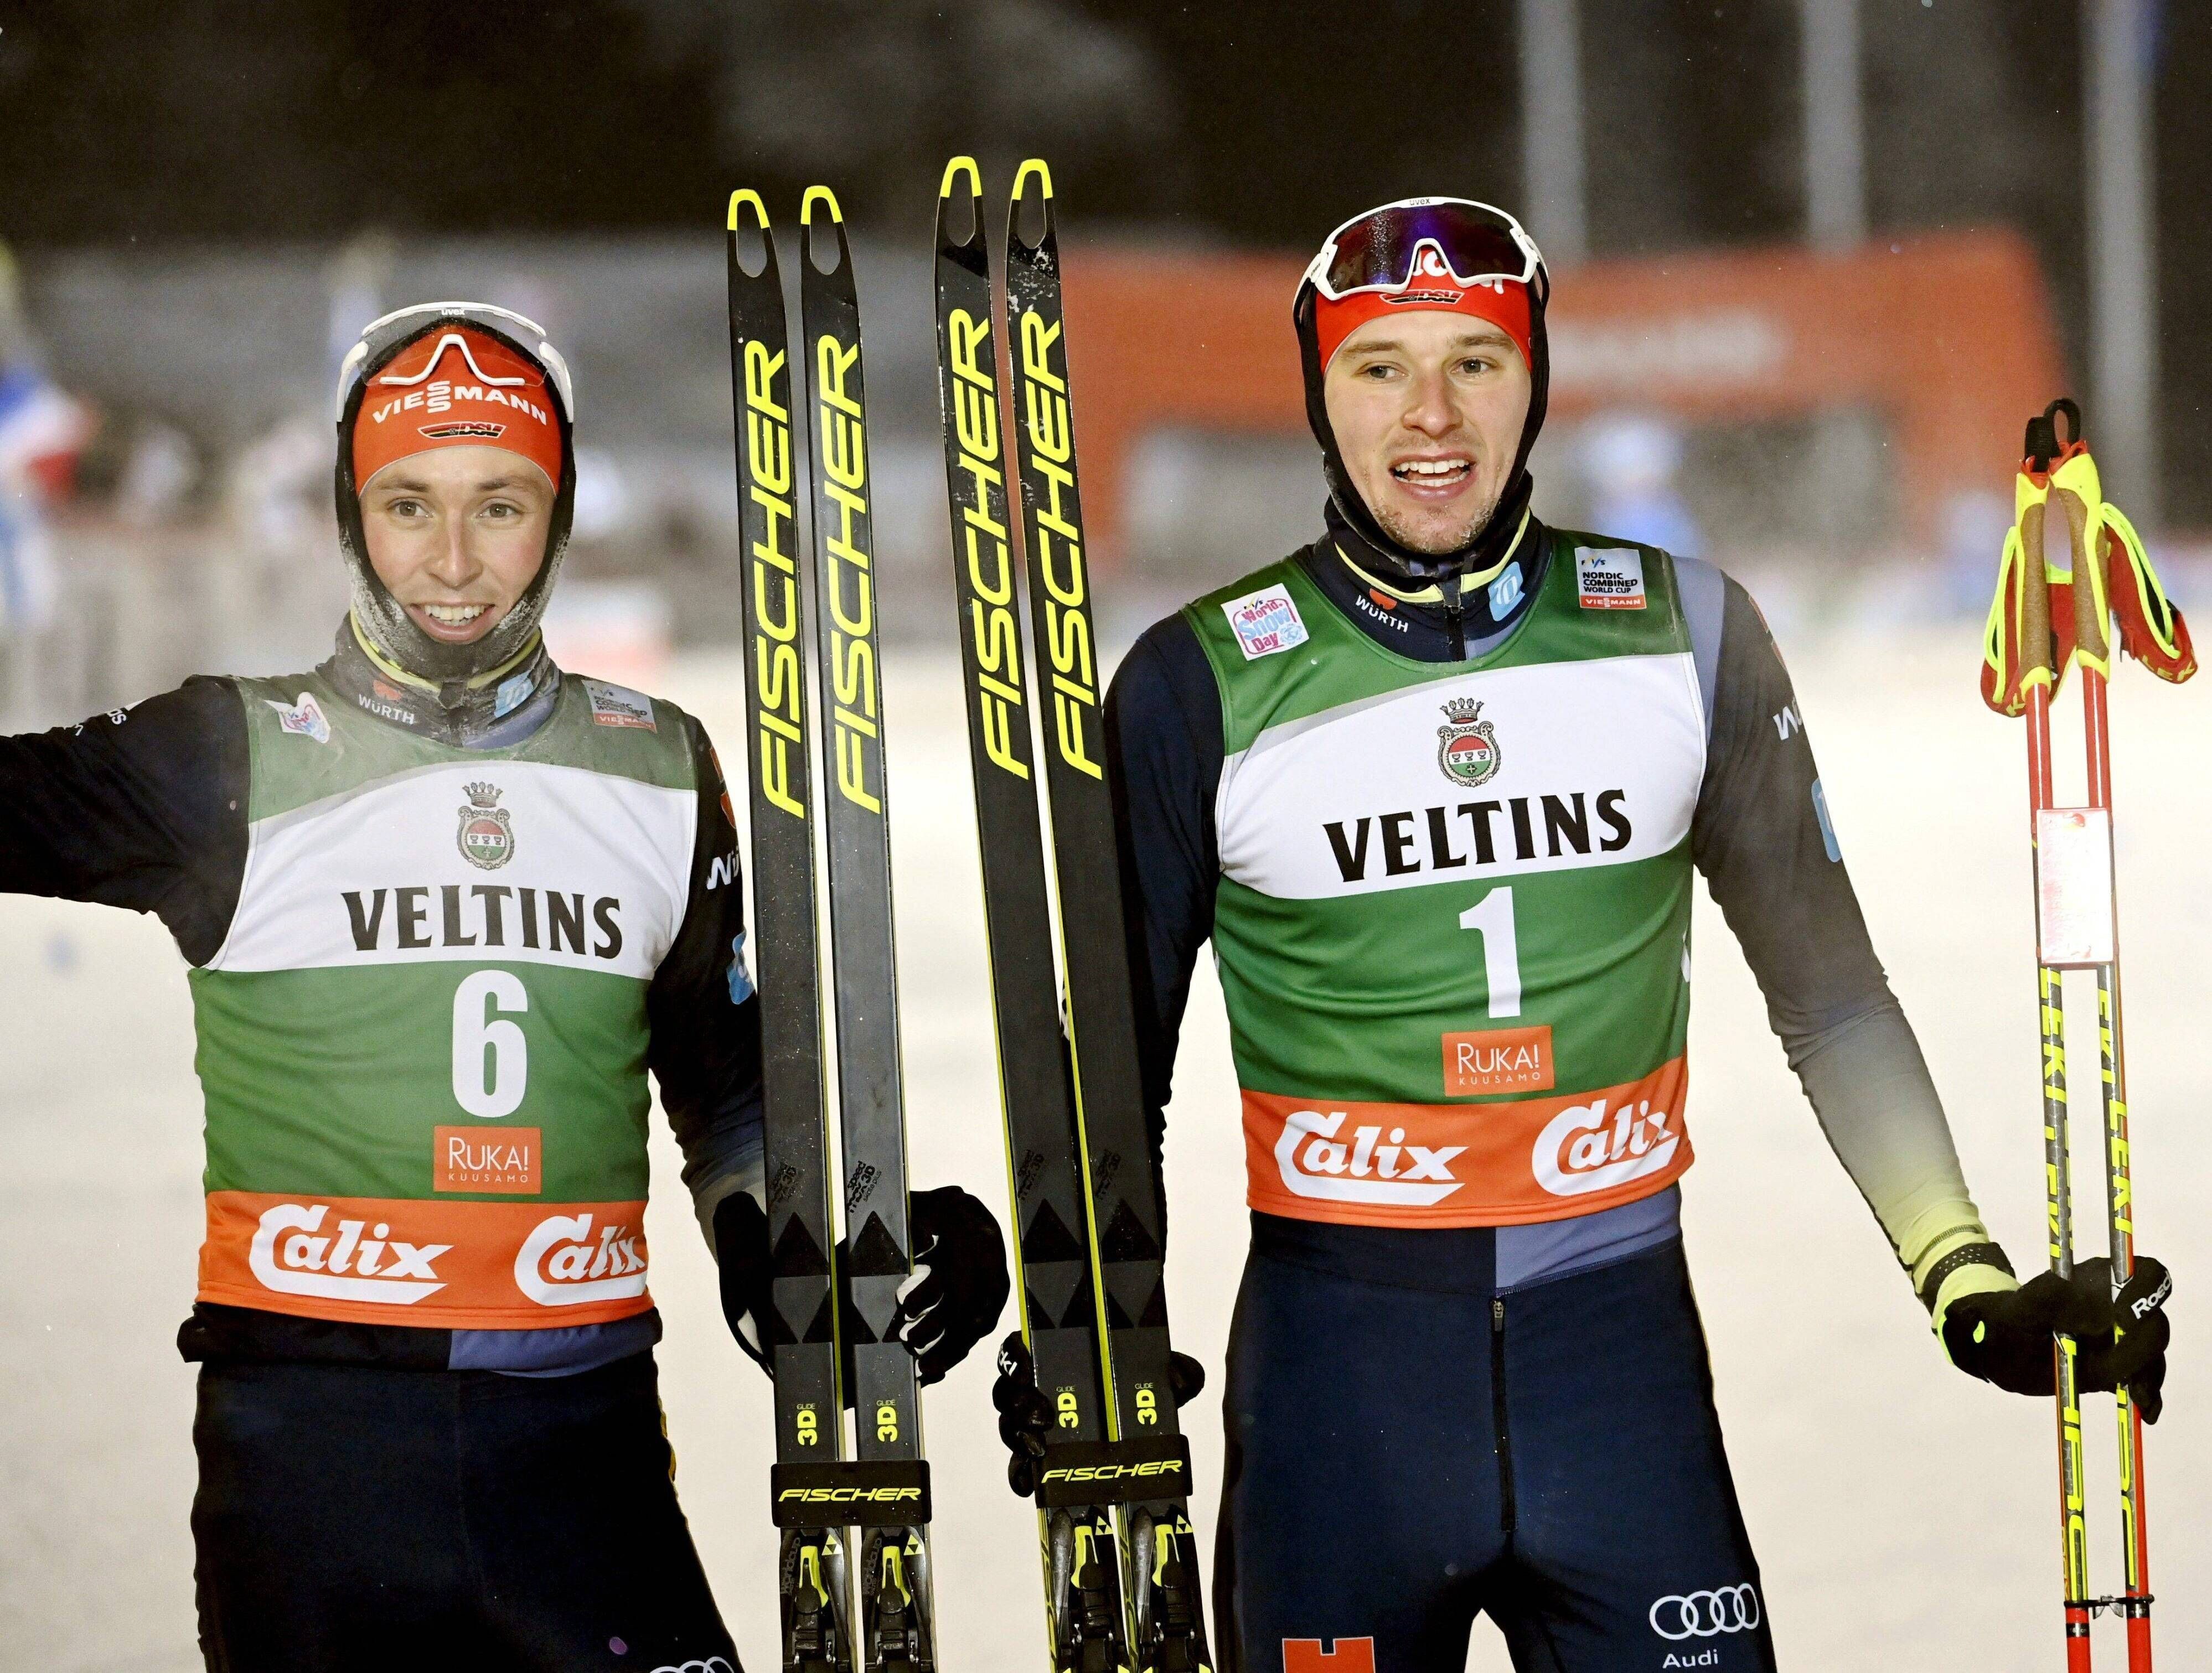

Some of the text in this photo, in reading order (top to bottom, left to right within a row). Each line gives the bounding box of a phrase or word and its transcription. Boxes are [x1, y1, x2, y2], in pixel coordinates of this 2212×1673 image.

[372, 380, 547, 426] VIESSMANN
[949, 308, 1028, 780] FISCHER
[1021, 311, 1102, 780] FISCHER
[744, 340, 804, 819] FISCHER
[818, 335, 881, 814] FISCHER
[1583, 579, 1638, 587] COMBINED
[1251, 632, 1279, 651] Day
[2142, 653, 2195, 682] LEK
[1323, 789, 1632, 883] VELTINS
[340, 884, 623, 959] VELTINS
[1459, 886, 1522, 1019] 1
[452, 970, 529, 1118] 6
[1457, 1043, 1539, 1075] RUKA!
[1459, 1071, 1541, 1085] KUUSAMO
[448, 1136, 529, 1172] RUKA!
[1274, 1110, 1469, 1206] Calix
[448, 1173, 529, 1183] KUUSAMO
[860, 1165, 876, 1184] 3D
[249, 1204, 454, 1304] Calix
[514, 1213, 648, 1306] Calix
[877, 1406, 898, 1442] 3D
[1057, 1392, 1079, 1428] 3D
[1136, 1389, 1157, 1425] 3D
[797, 1410, 818, 1446] 3D
[1041, 1460, 1183, 1484] FISCHER
[778, 1487, 922, 1503] FISCHER
[1662, 1649, 1718, 1669] Audi
